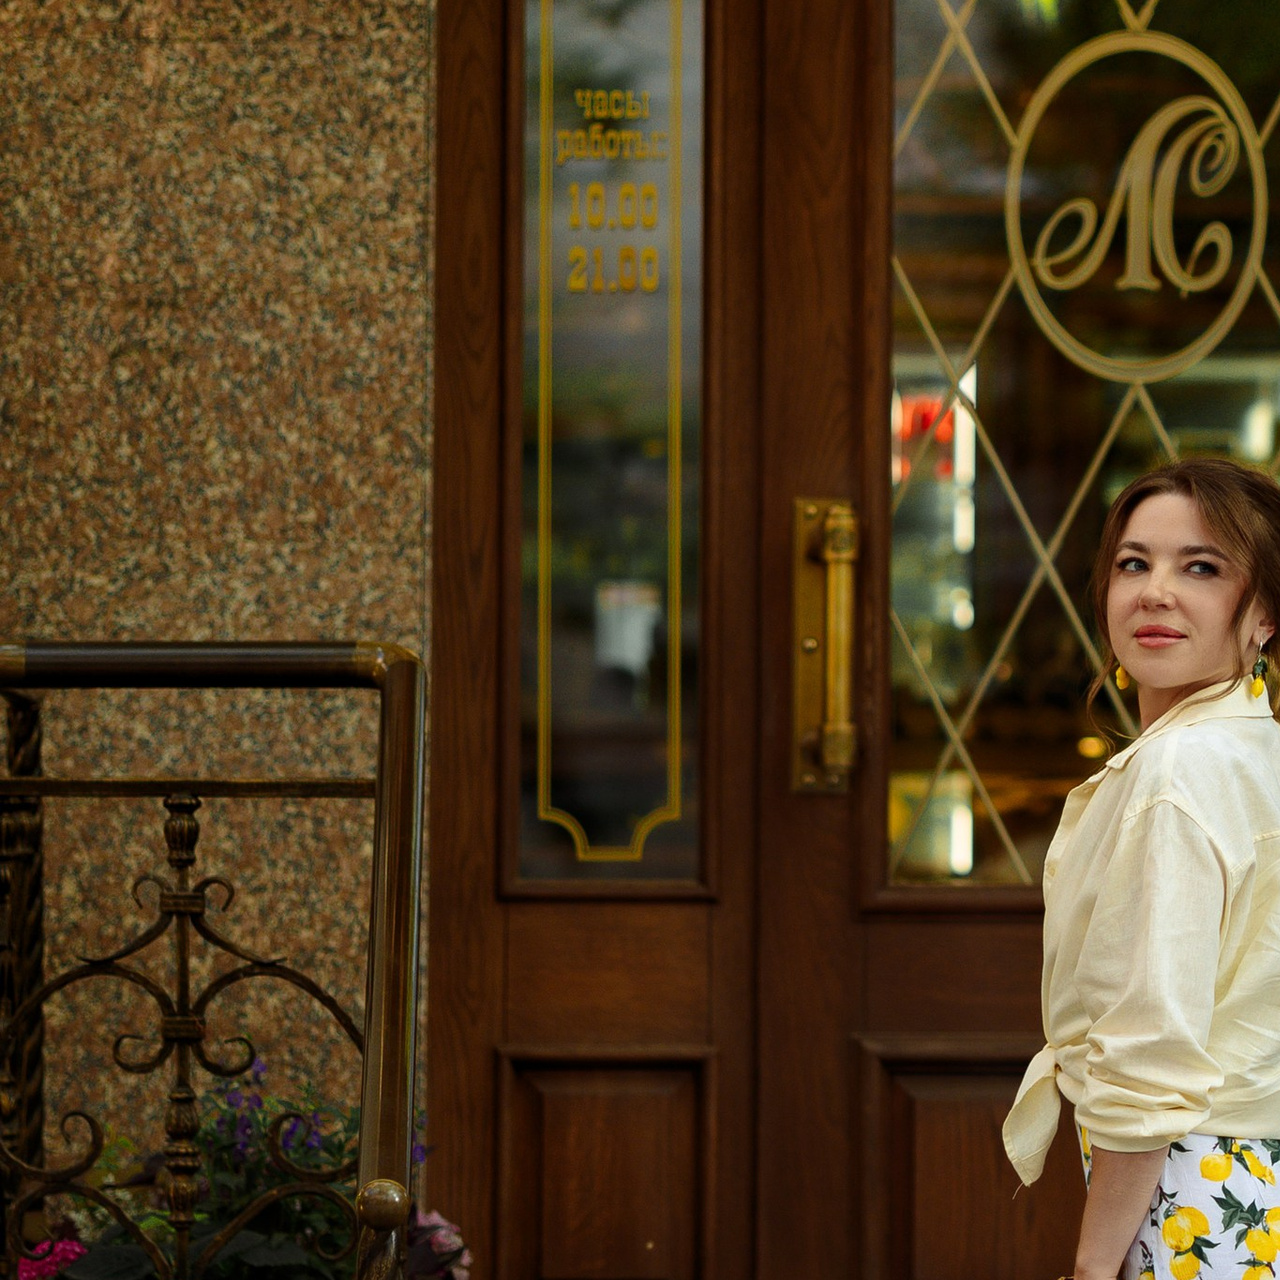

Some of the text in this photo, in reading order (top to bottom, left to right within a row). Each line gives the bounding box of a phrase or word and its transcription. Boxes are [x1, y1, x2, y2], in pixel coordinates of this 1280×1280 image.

[574, 88, 650, 119] часы
[568, 182, 659, 229] 10.00
[567, 245, 660, 294] 21.00
